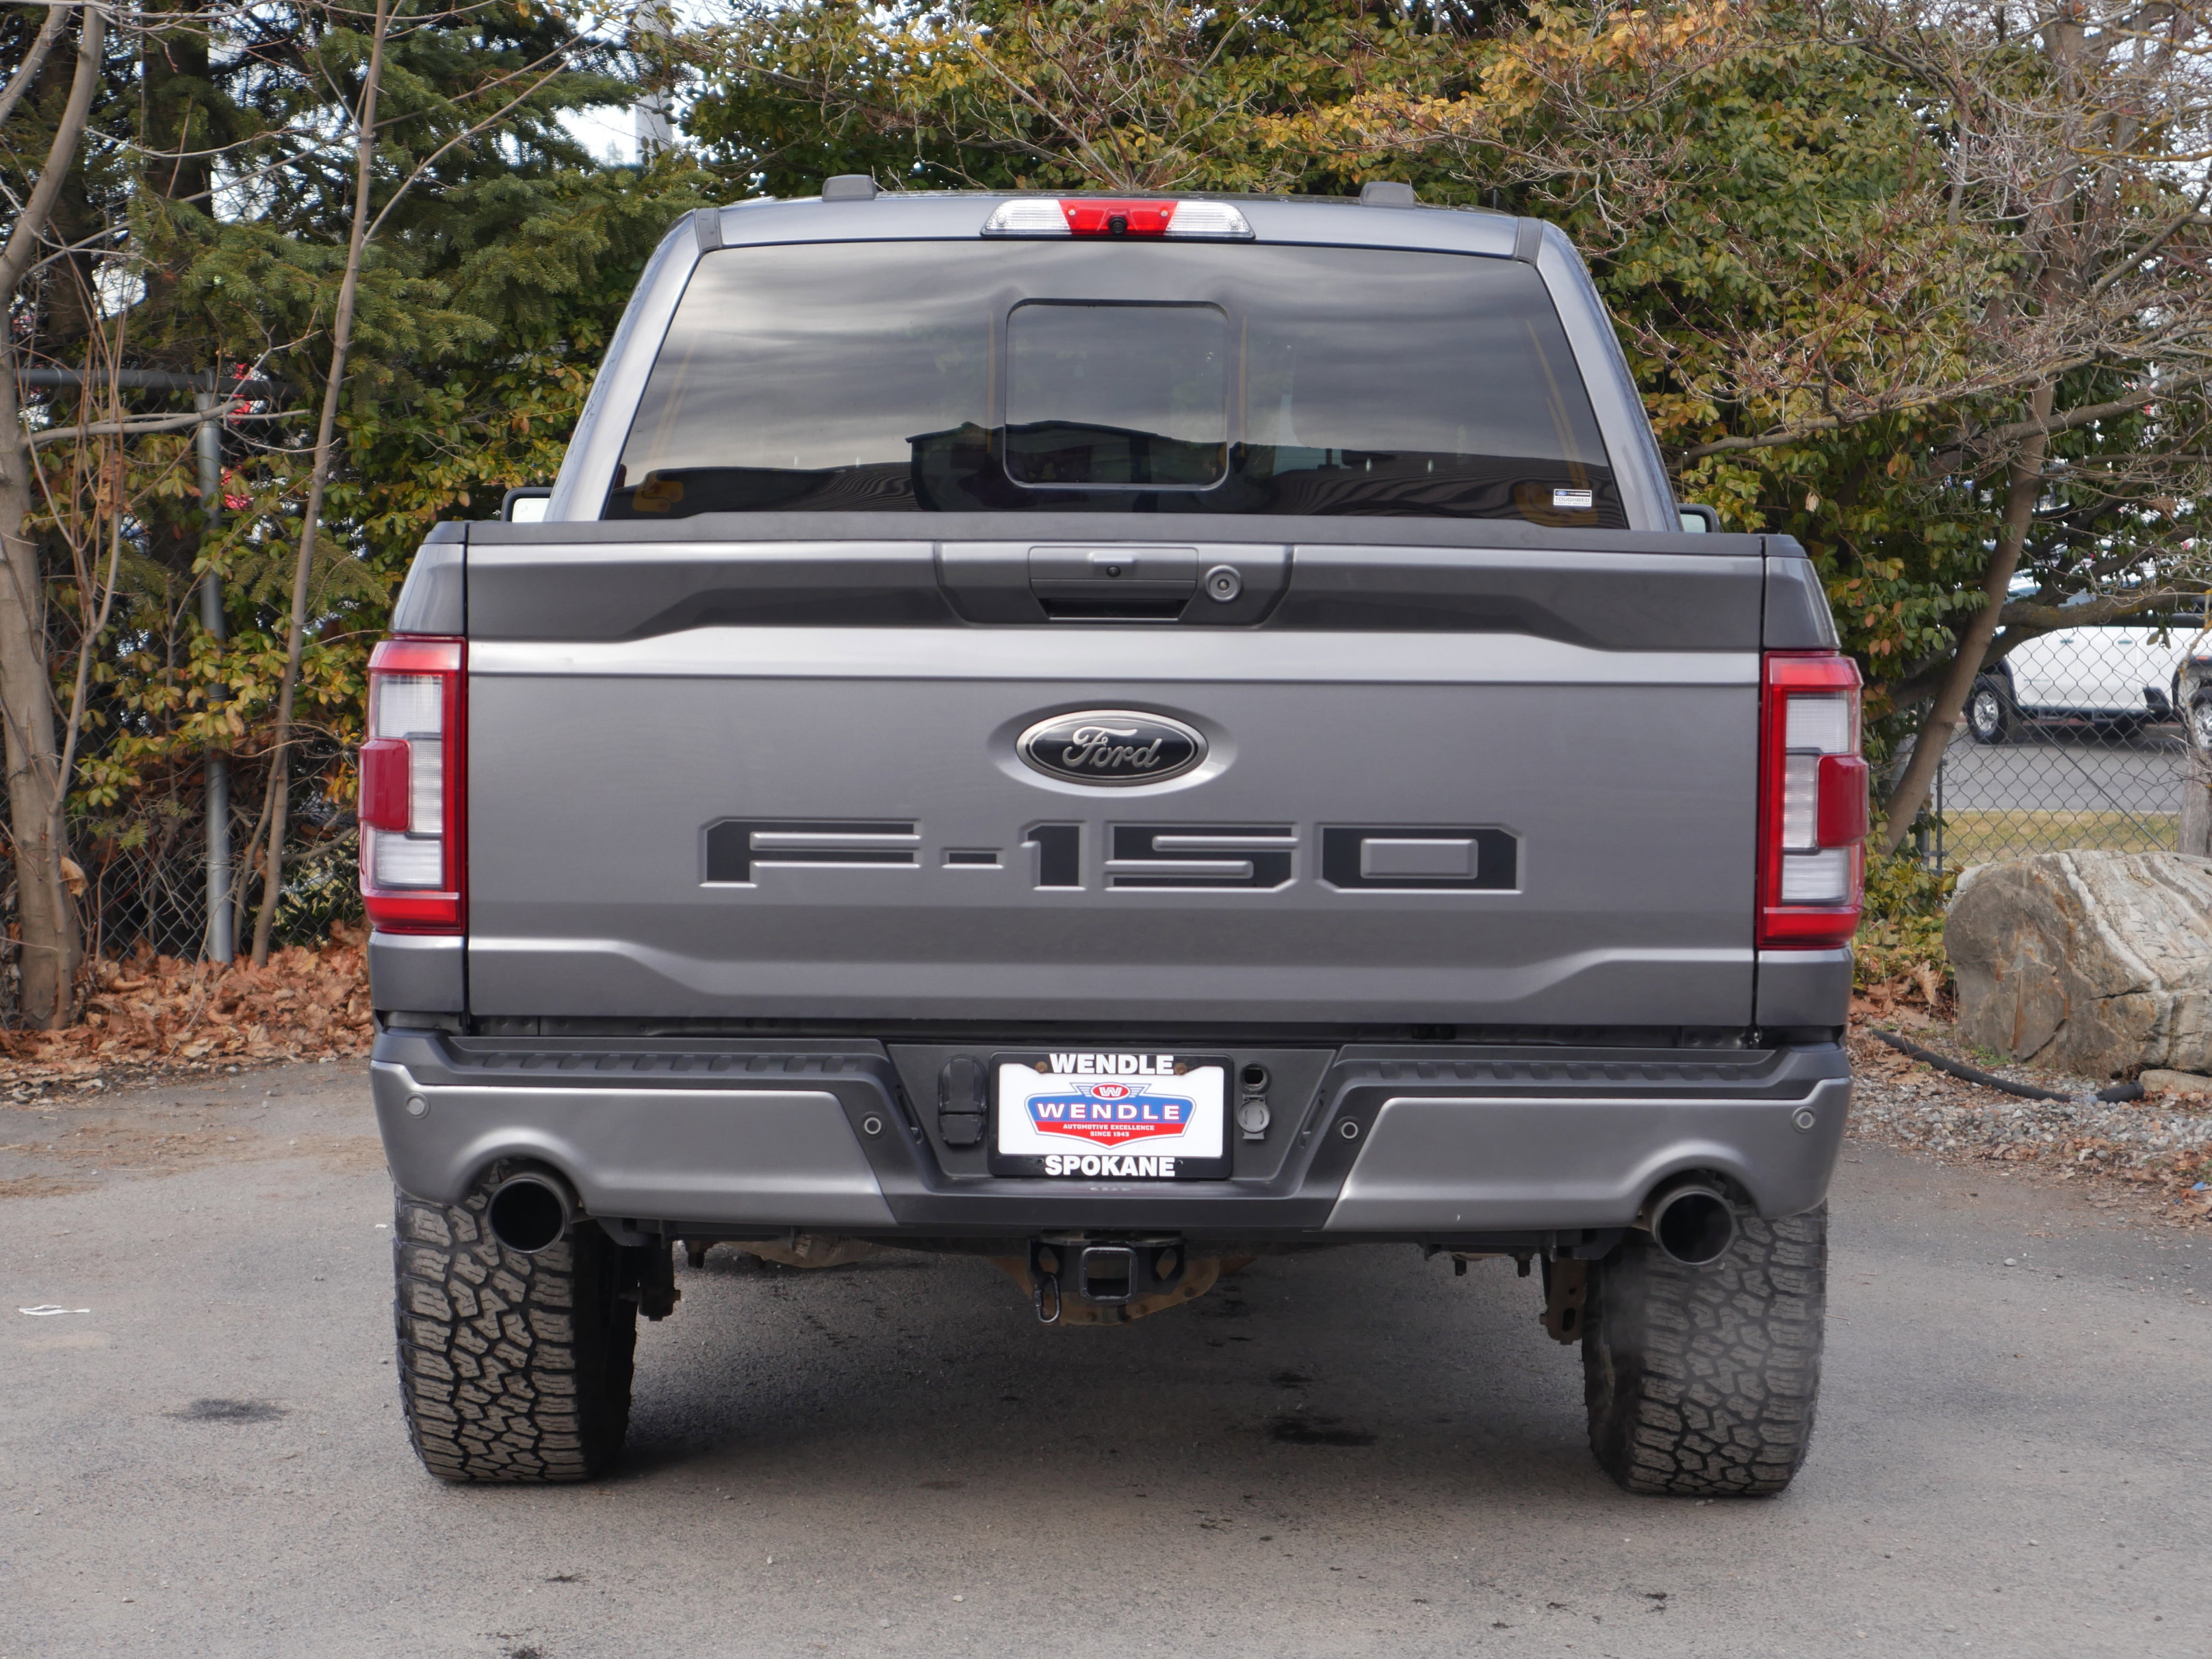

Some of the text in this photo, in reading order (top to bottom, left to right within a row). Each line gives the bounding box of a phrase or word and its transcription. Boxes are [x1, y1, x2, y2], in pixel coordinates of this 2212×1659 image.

[1062, 725, 1163, 768] Ford
[699, 817, 1523, 894] F-150
[1050, 1053, 1174, 1075] WENDLE
[1099, 1086, 1123, 1097] W
[1037, 1103, 1180, 1120] WENDLE
[1044, 1155, 1176, 1177] SPOKANE
